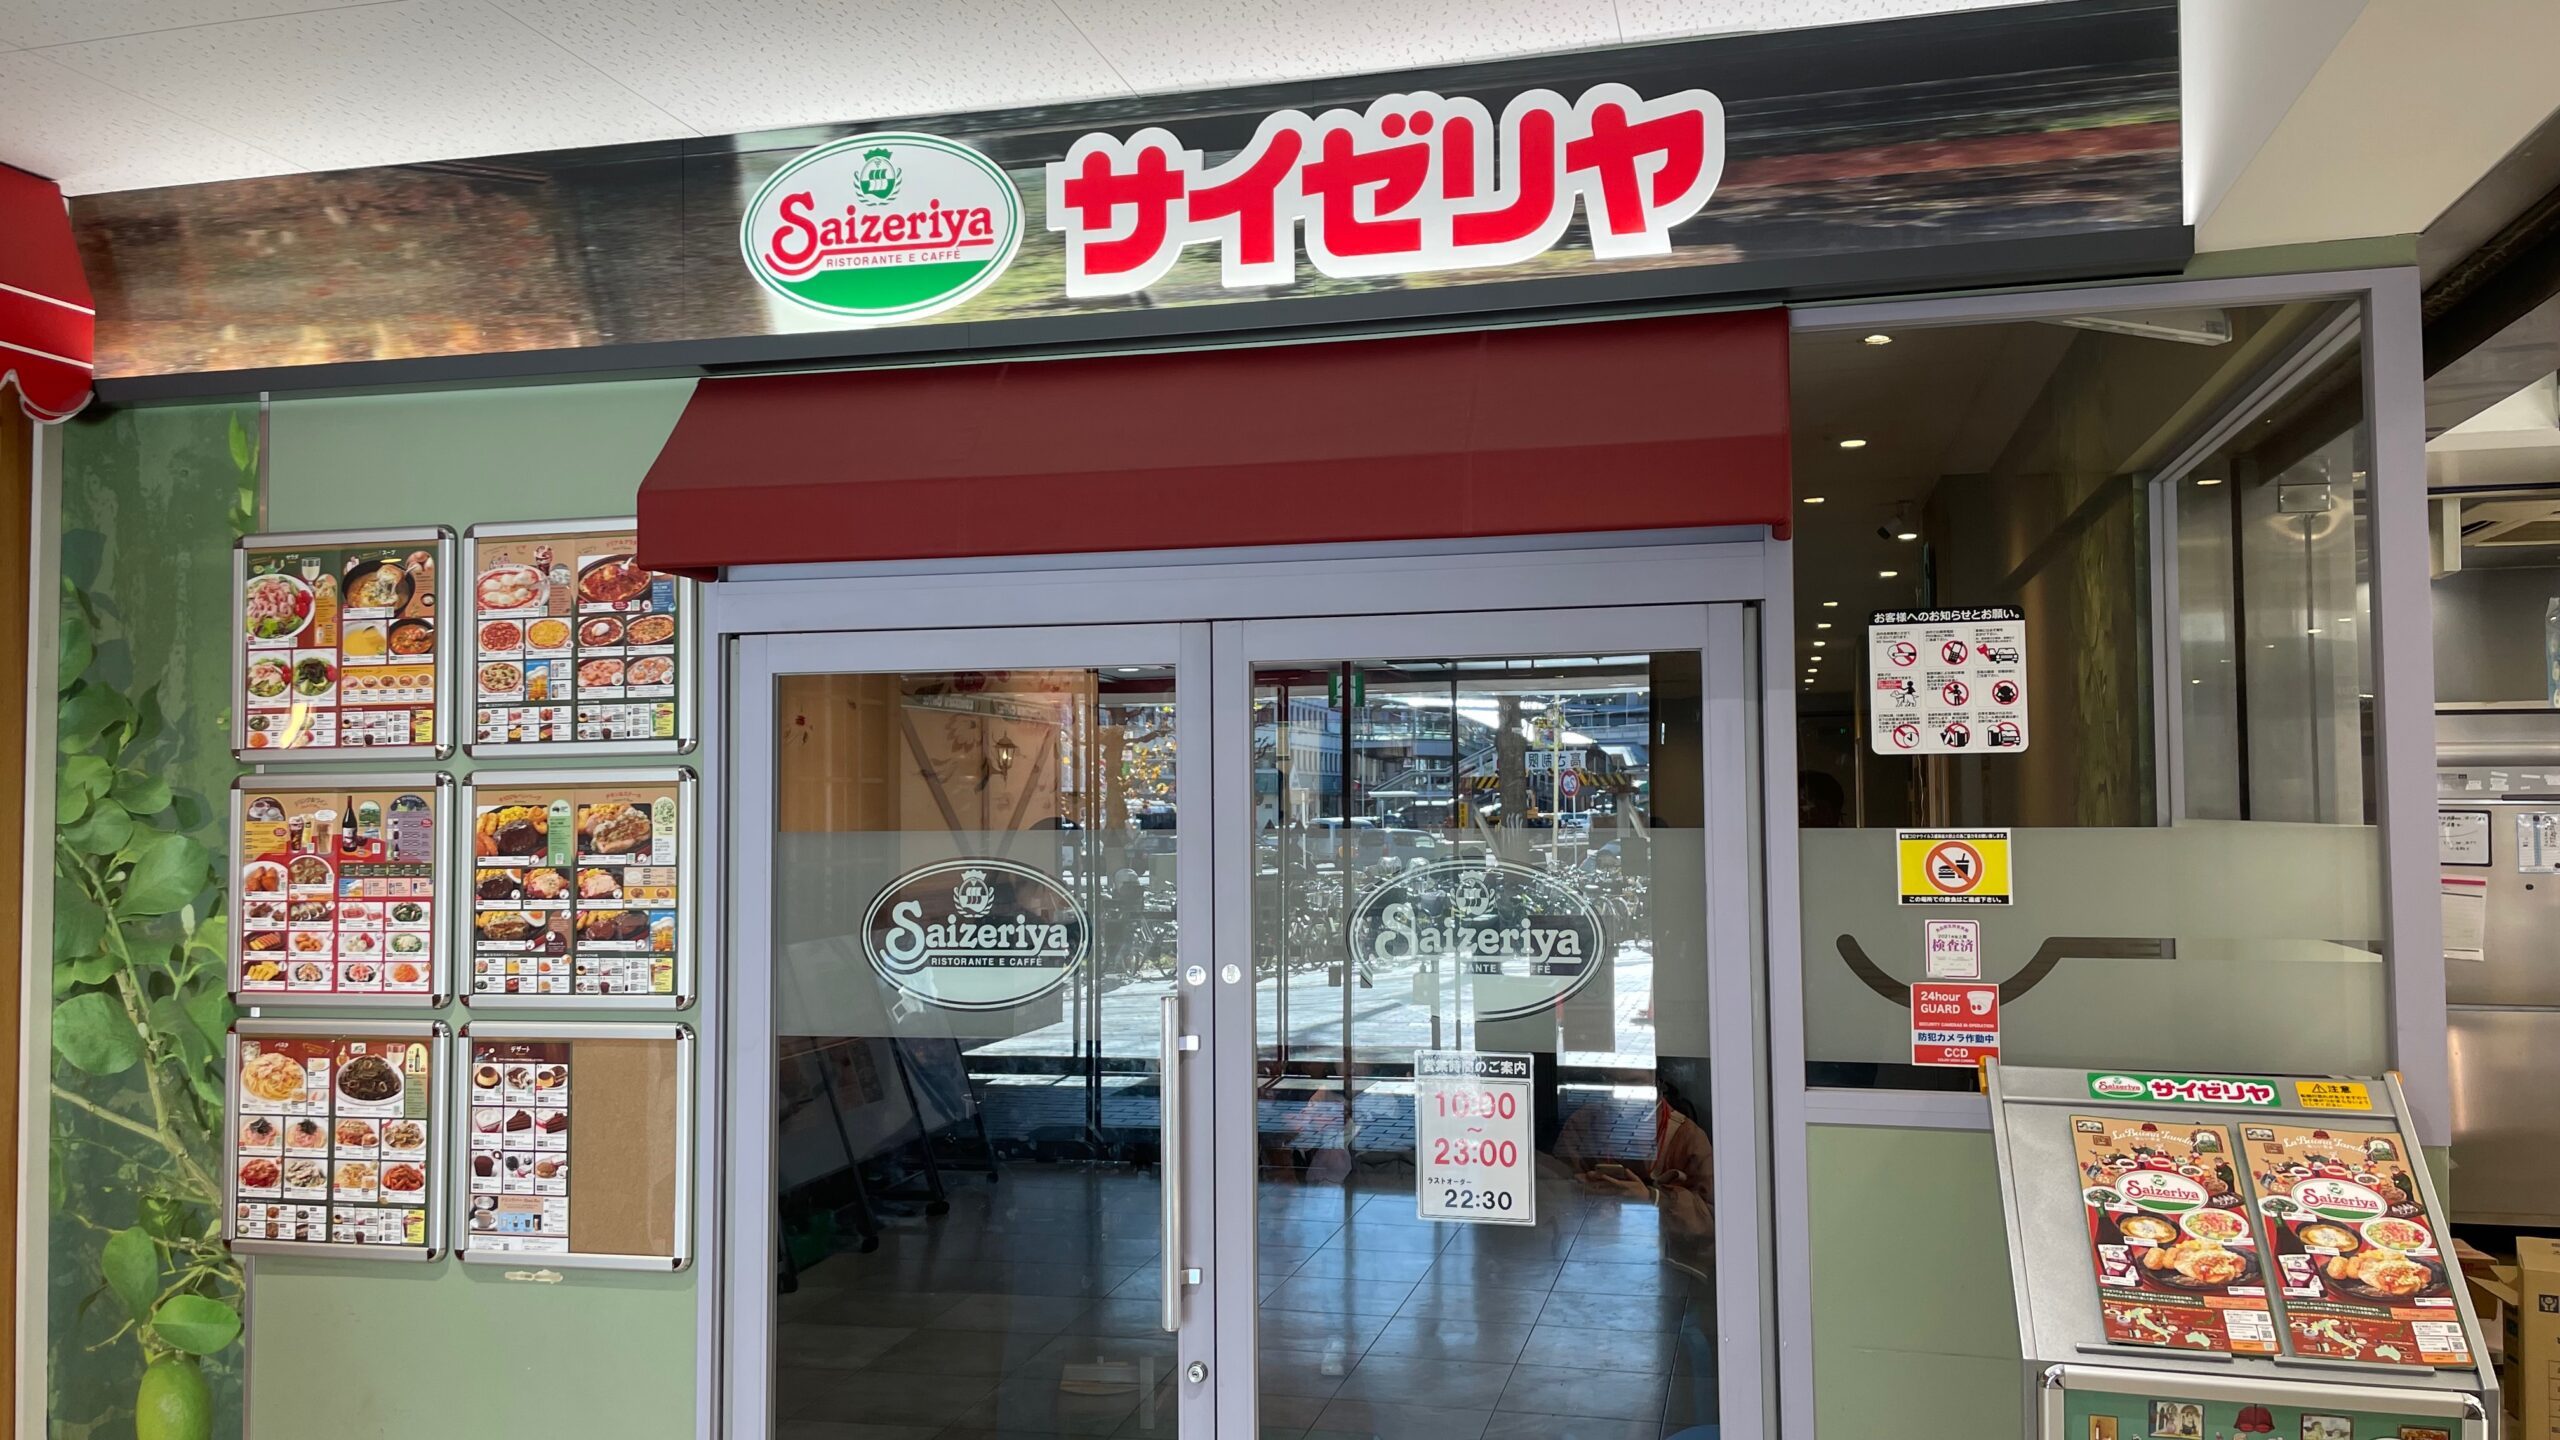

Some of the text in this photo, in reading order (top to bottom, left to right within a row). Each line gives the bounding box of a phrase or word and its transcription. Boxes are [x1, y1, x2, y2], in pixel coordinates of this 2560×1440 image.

[1062, 101, 1706, 277] サイゼリヤ
[771, 191, 994, 264] Saizeriya
[826, 254, 903, 268] RISTORANTE
[908, 252, 916, 262] E
[1874, 608, 2020, 623] お客様へのお知らせとお願い。
[885, 900, 1069, 961] Saizeriya
[1375, 902, 1582, 963] Saizeriya
[1933, 938, 1973, 952] 検査済
[931, 957, 995, 966] RISTORANTE
[999, 957, 1006, 966] E
[1921, 991, 1961, 1002] 24hour
[1921, 1004, 1961, 1014] GUARD
[1918, 1032, 1994, 1044] 防犯カメラ作動中
[1944, 1047, 1968, 1058] CCD
[2152, 1081, 2271, 1101] サイゼリヤ
[2328, 1085, 2352, 1093] 注意
[1434, 1138, 1517, 1168] 23:00
[1427, 1176, 1472, 1185] ラストオーダー
[2127, 1180, 2199, 1200] Saizeriya
[1444, 1188, 1512, 1210] 22:30
[2303, 1188, 2378, 1209] Saizeriya
